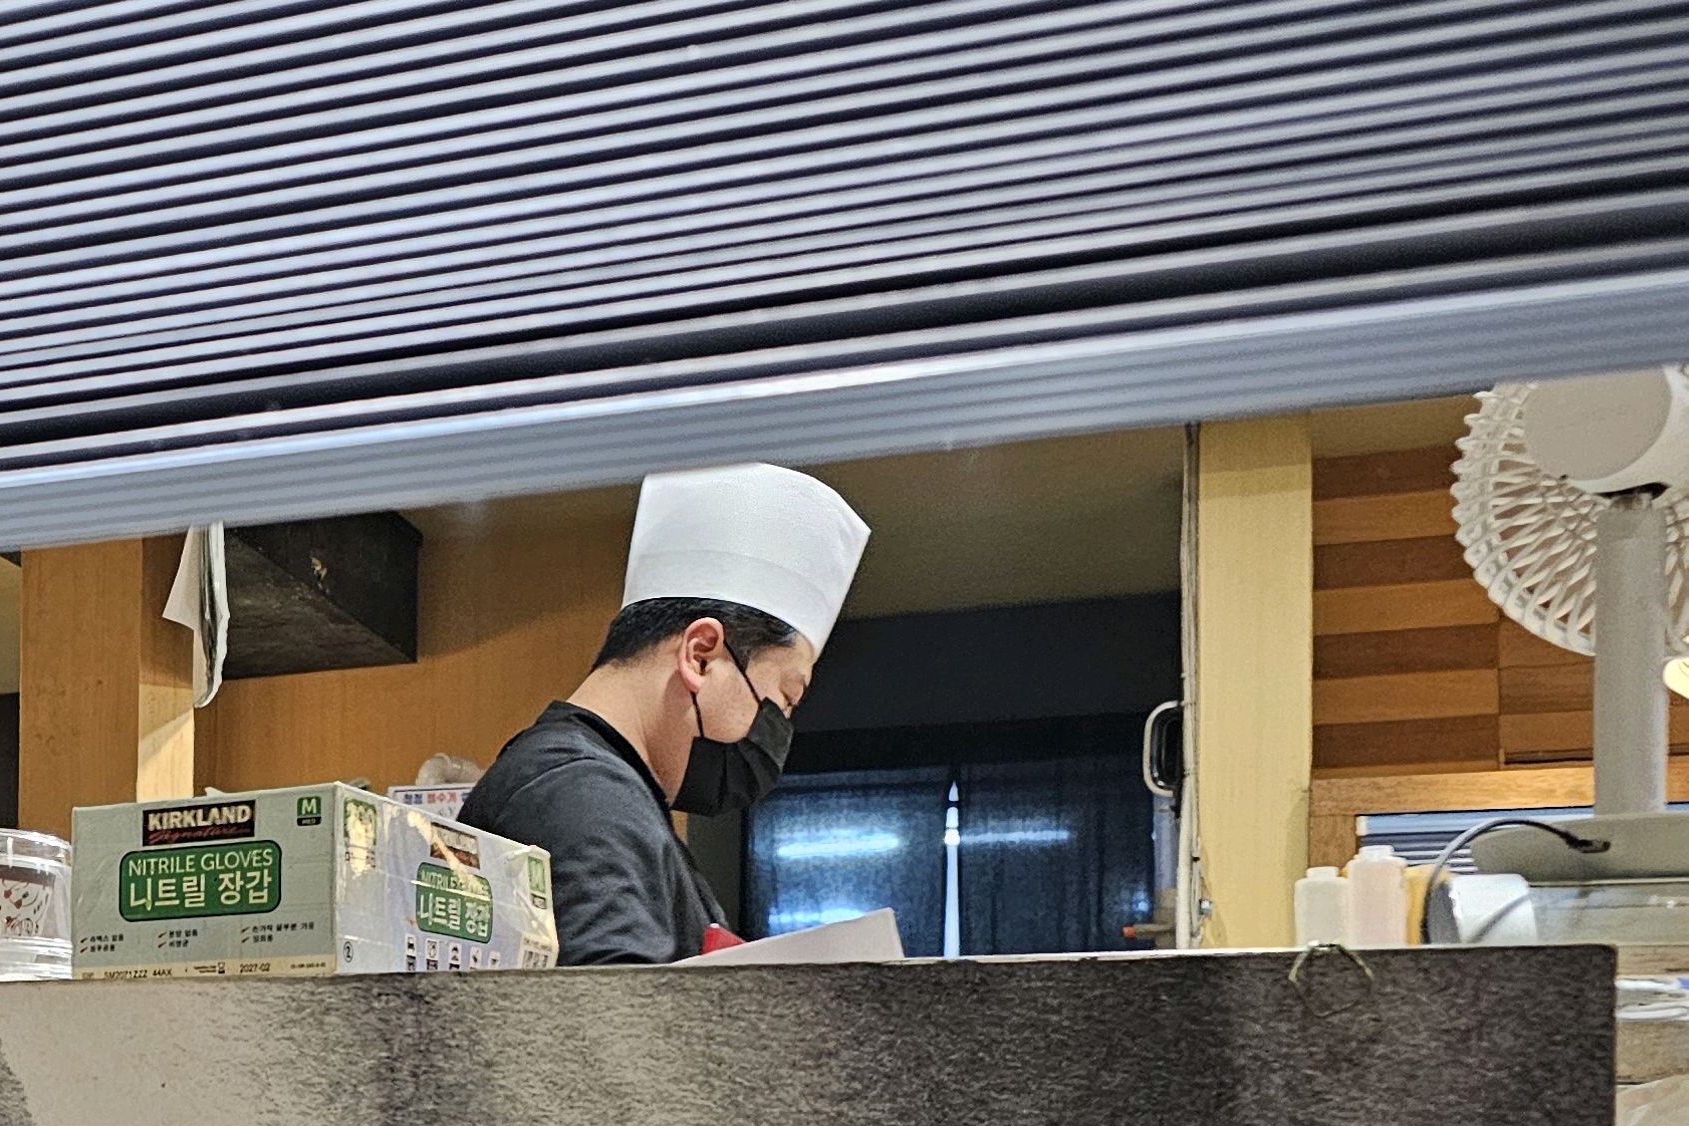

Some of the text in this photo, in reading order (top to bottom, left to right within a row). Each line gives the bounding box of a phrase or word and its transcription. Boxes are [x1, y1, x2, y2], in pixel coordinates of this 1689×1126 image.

[147, 803, 253, 832] KIRKLAND
[301, 798, 317, 815] M
[128, 848, 274, 877] NITRILE GLOVES
[129, 868, 273, 910] 니트릴 장갑
[420, 893, 461, 930] 니트릴
